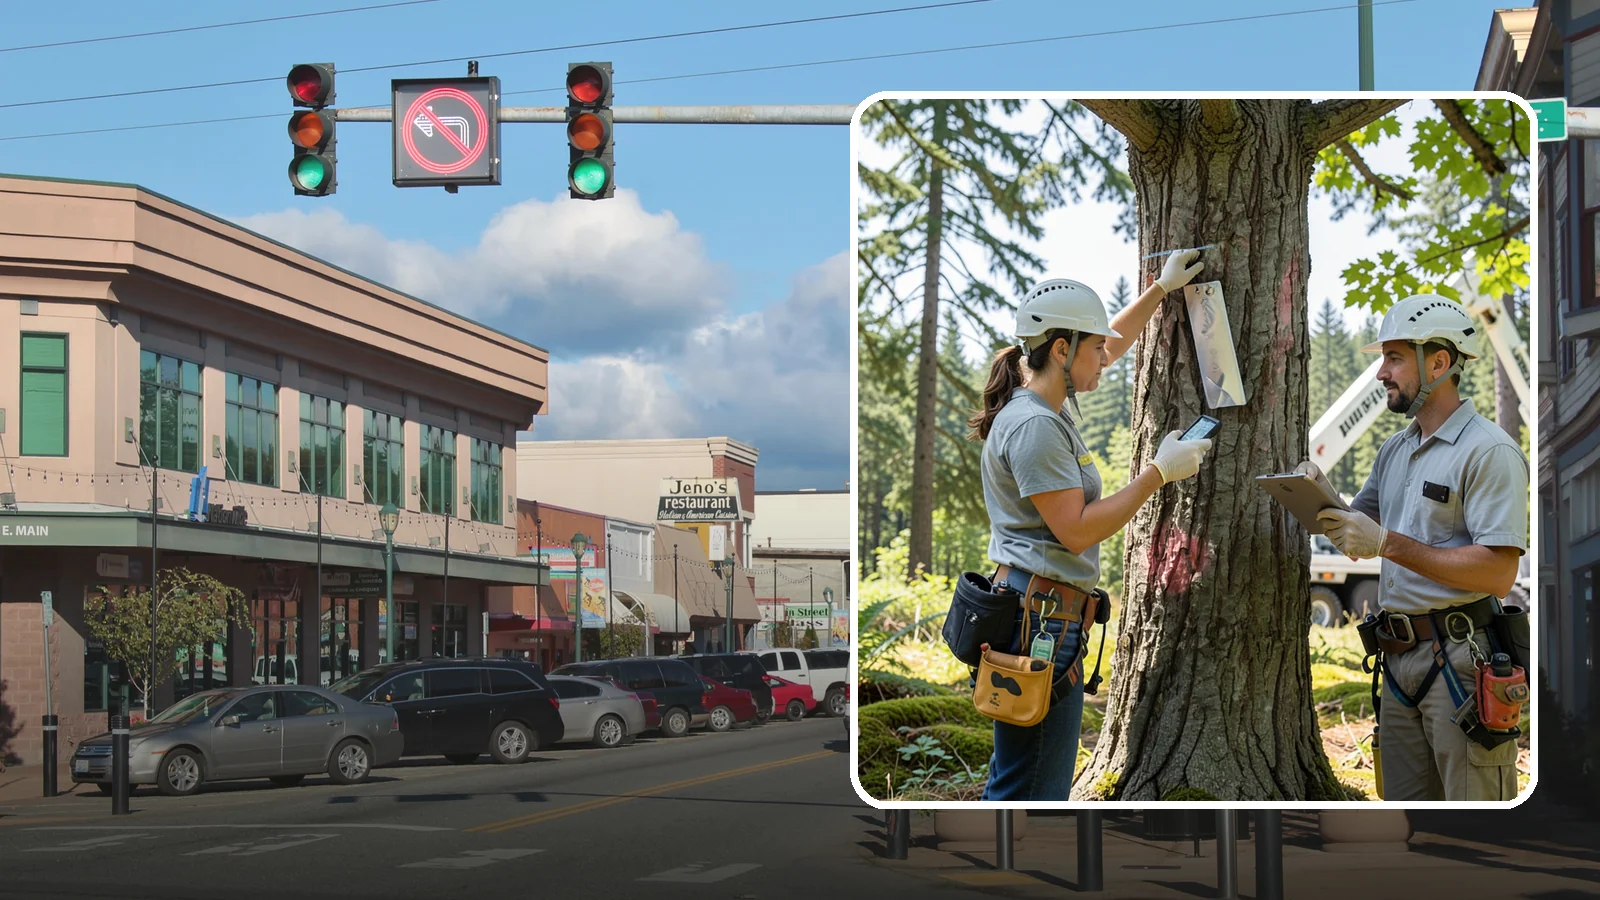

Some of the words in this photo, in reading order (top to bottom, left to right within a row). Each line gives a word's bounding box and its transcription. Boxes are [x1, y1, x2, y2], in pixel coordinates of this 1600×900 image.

[669, 480, 728, 494] Jeno's
[665, 496, 731, 509] restaurant
[659, 510, 682, 519] Italian
[686, 510, 714, 519] American
[715, 510, 737, 519] Cuisine
[2, 525, 13, 536] E.
[15, 525, 49, 536] MAIN
[797, 608, 829, 617] Street
